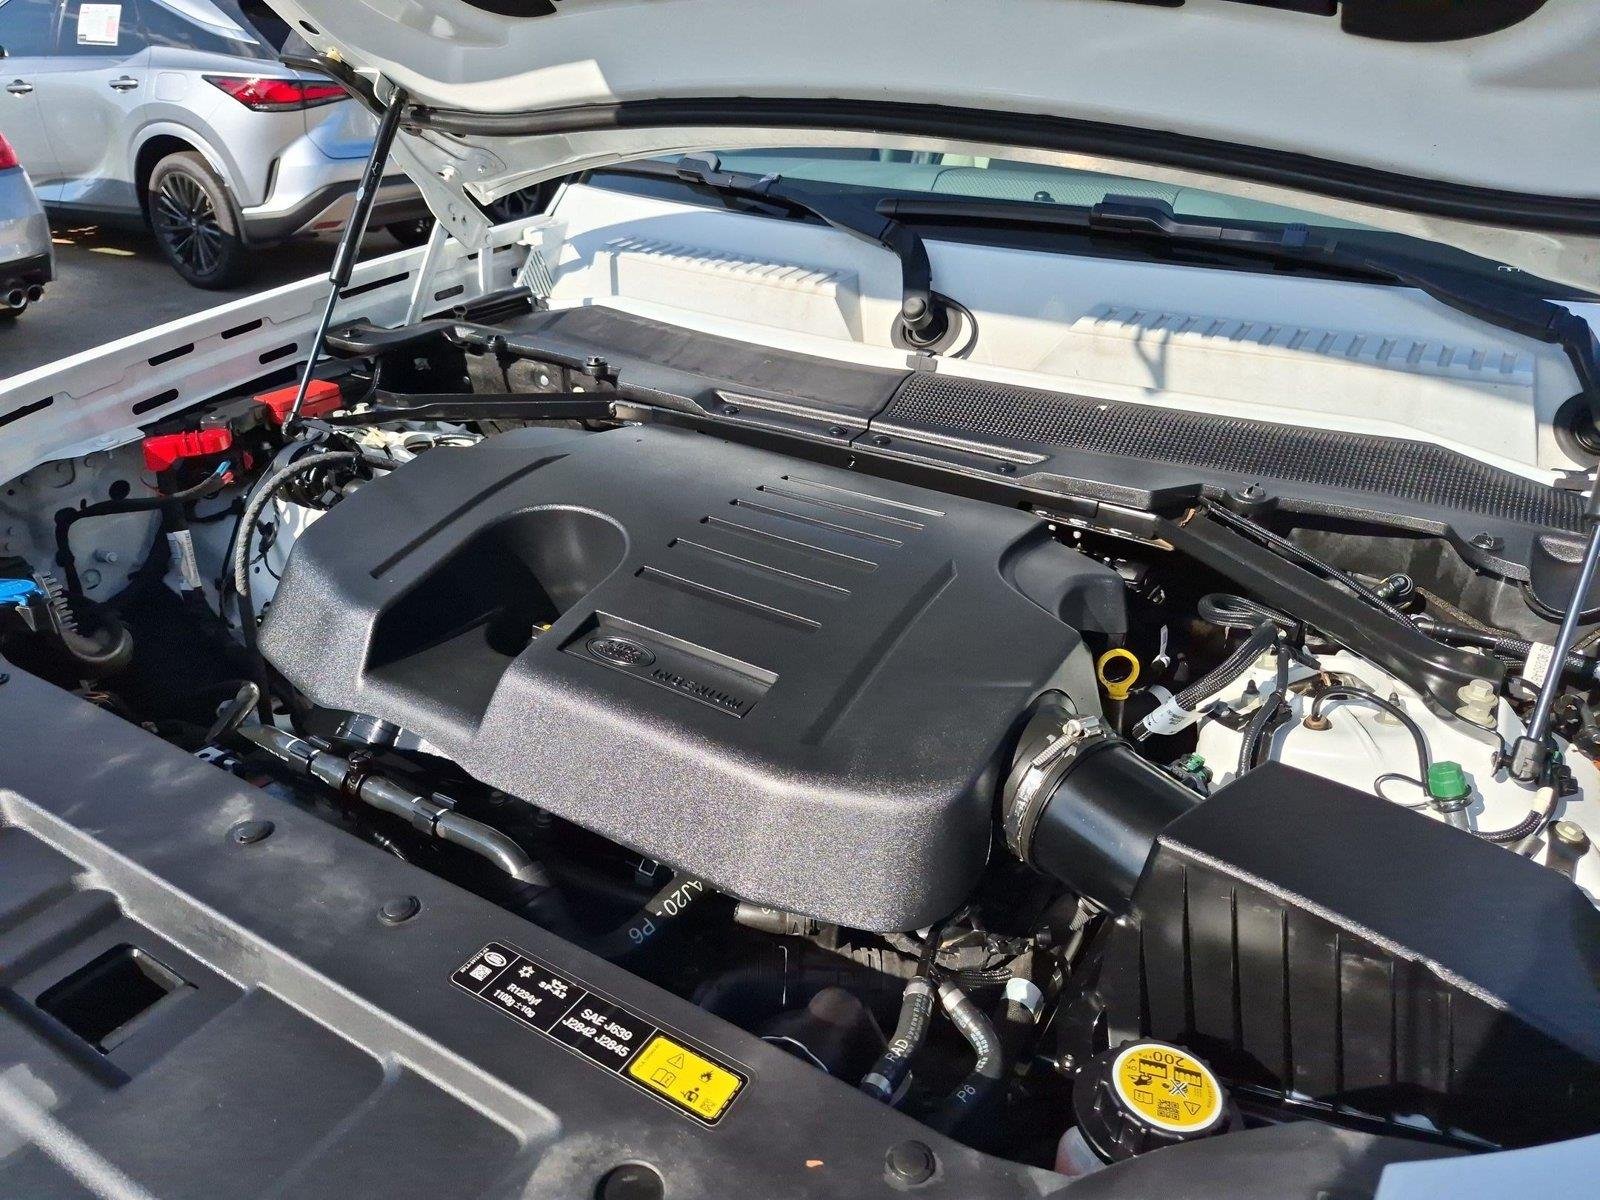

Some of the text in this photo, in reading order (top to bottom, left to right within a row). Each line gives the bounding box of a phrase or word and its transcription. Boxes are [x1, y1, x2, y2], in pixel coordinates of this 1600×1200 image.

[628, 917, 656, 944] P6
[562, 1017, 597, 1038] J2842
[594, 1034, 630, 1057] J2845
[580, 1008, 633, 1041] SAE J639
[885, 1039, 909, 1062] RAD
[1153, 1051, 1184, 1067] 200
[956, 1084, 976, 1103] P6
